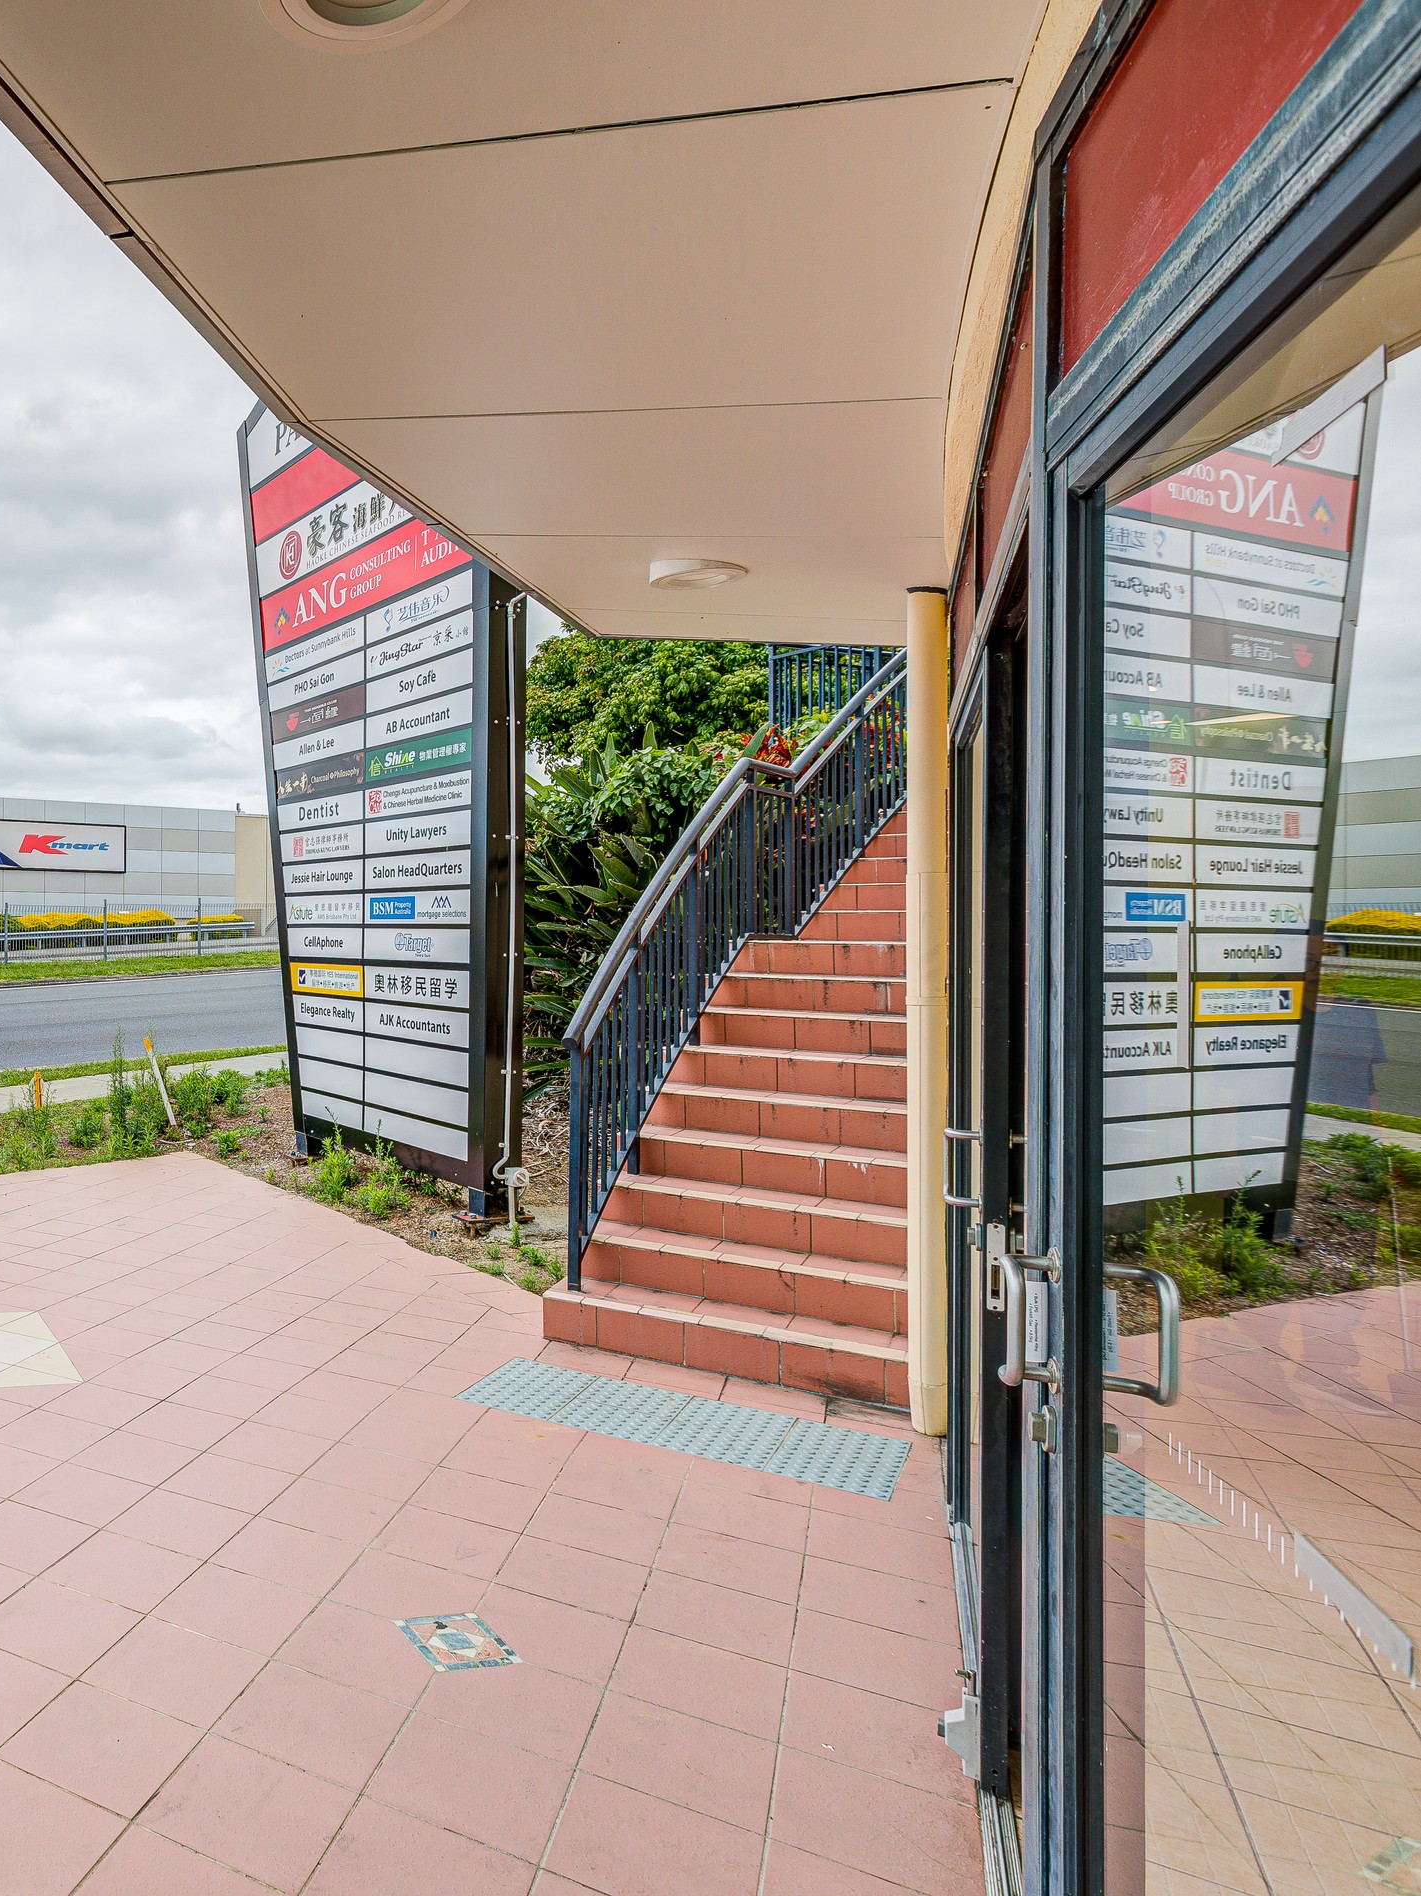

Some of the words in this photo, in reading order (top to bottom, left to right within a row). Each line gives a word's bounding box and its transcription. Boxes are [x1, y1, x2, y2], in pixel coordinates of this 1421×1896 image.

[306, 553, 328, 570] HAOKE
[330, 536, 360, 556] CHINESE
[360, 514, 396, 538] SEAFOOD
[349, 538, 412, 580] CONSULTING
[349, 574, 382, 599] GROUP
[292, 572, 348, 628] ANG
[284, 648, 304, 664] Doctors
[311, 632, 340, 653] Sunnybank
[342, 627, 356, 640] Hills
[294, 680, 308, 695] PHO
[310, 676, 319, 690] Sai
[320, 672, 334, 685] Gon
[398, 678, 414, 693] Soy
[386, 721, 398, 735] AB
[399, 707, 450, 732] Accountant
[298, 743, 315, 756] Allen
[316, 740, 322, 750] &
[322, 738, 334, 749] Lee
[384, 750, 415, 767] Shine
[401, 784, 432, 796] Acupuncture
[438, 777, 470, 788] Moxibustion
[388, 800, 406, 809] Chinese
[407, 797, 423, 806] Herbal
[424, 793, 446, 803] Medicine
[447, 791, 463, 800] Clinic
[298, 802, 339, 821] Dentist
[386, 828, 409, 842] Unity
[410, 824, 447, 840] Lawyers
[19, 834, 110, 855] Kmart
[291, 873, 310, 884] Jessie
[311, 871, 325, 882] Hair
[326, 870, 353, 883] Lounge
[372, 866, 397, 879] Salon
[398, 862, 462, 878] HeadQuarters
[373, 902, 394, 915] BSM
[417, 910, 440, 919] mortgage
[442, 910, 467, 918] selections
[304, 936, 343, 950] CellAphone
[334, 972, 358, 980] International
[300, 1003, 331, 1018] Elegance
[332, 1006, 355, 1022] Realty
[379, 1014, 394, 1027] AJK
[396, 1016, 451, 1035] Accountants
